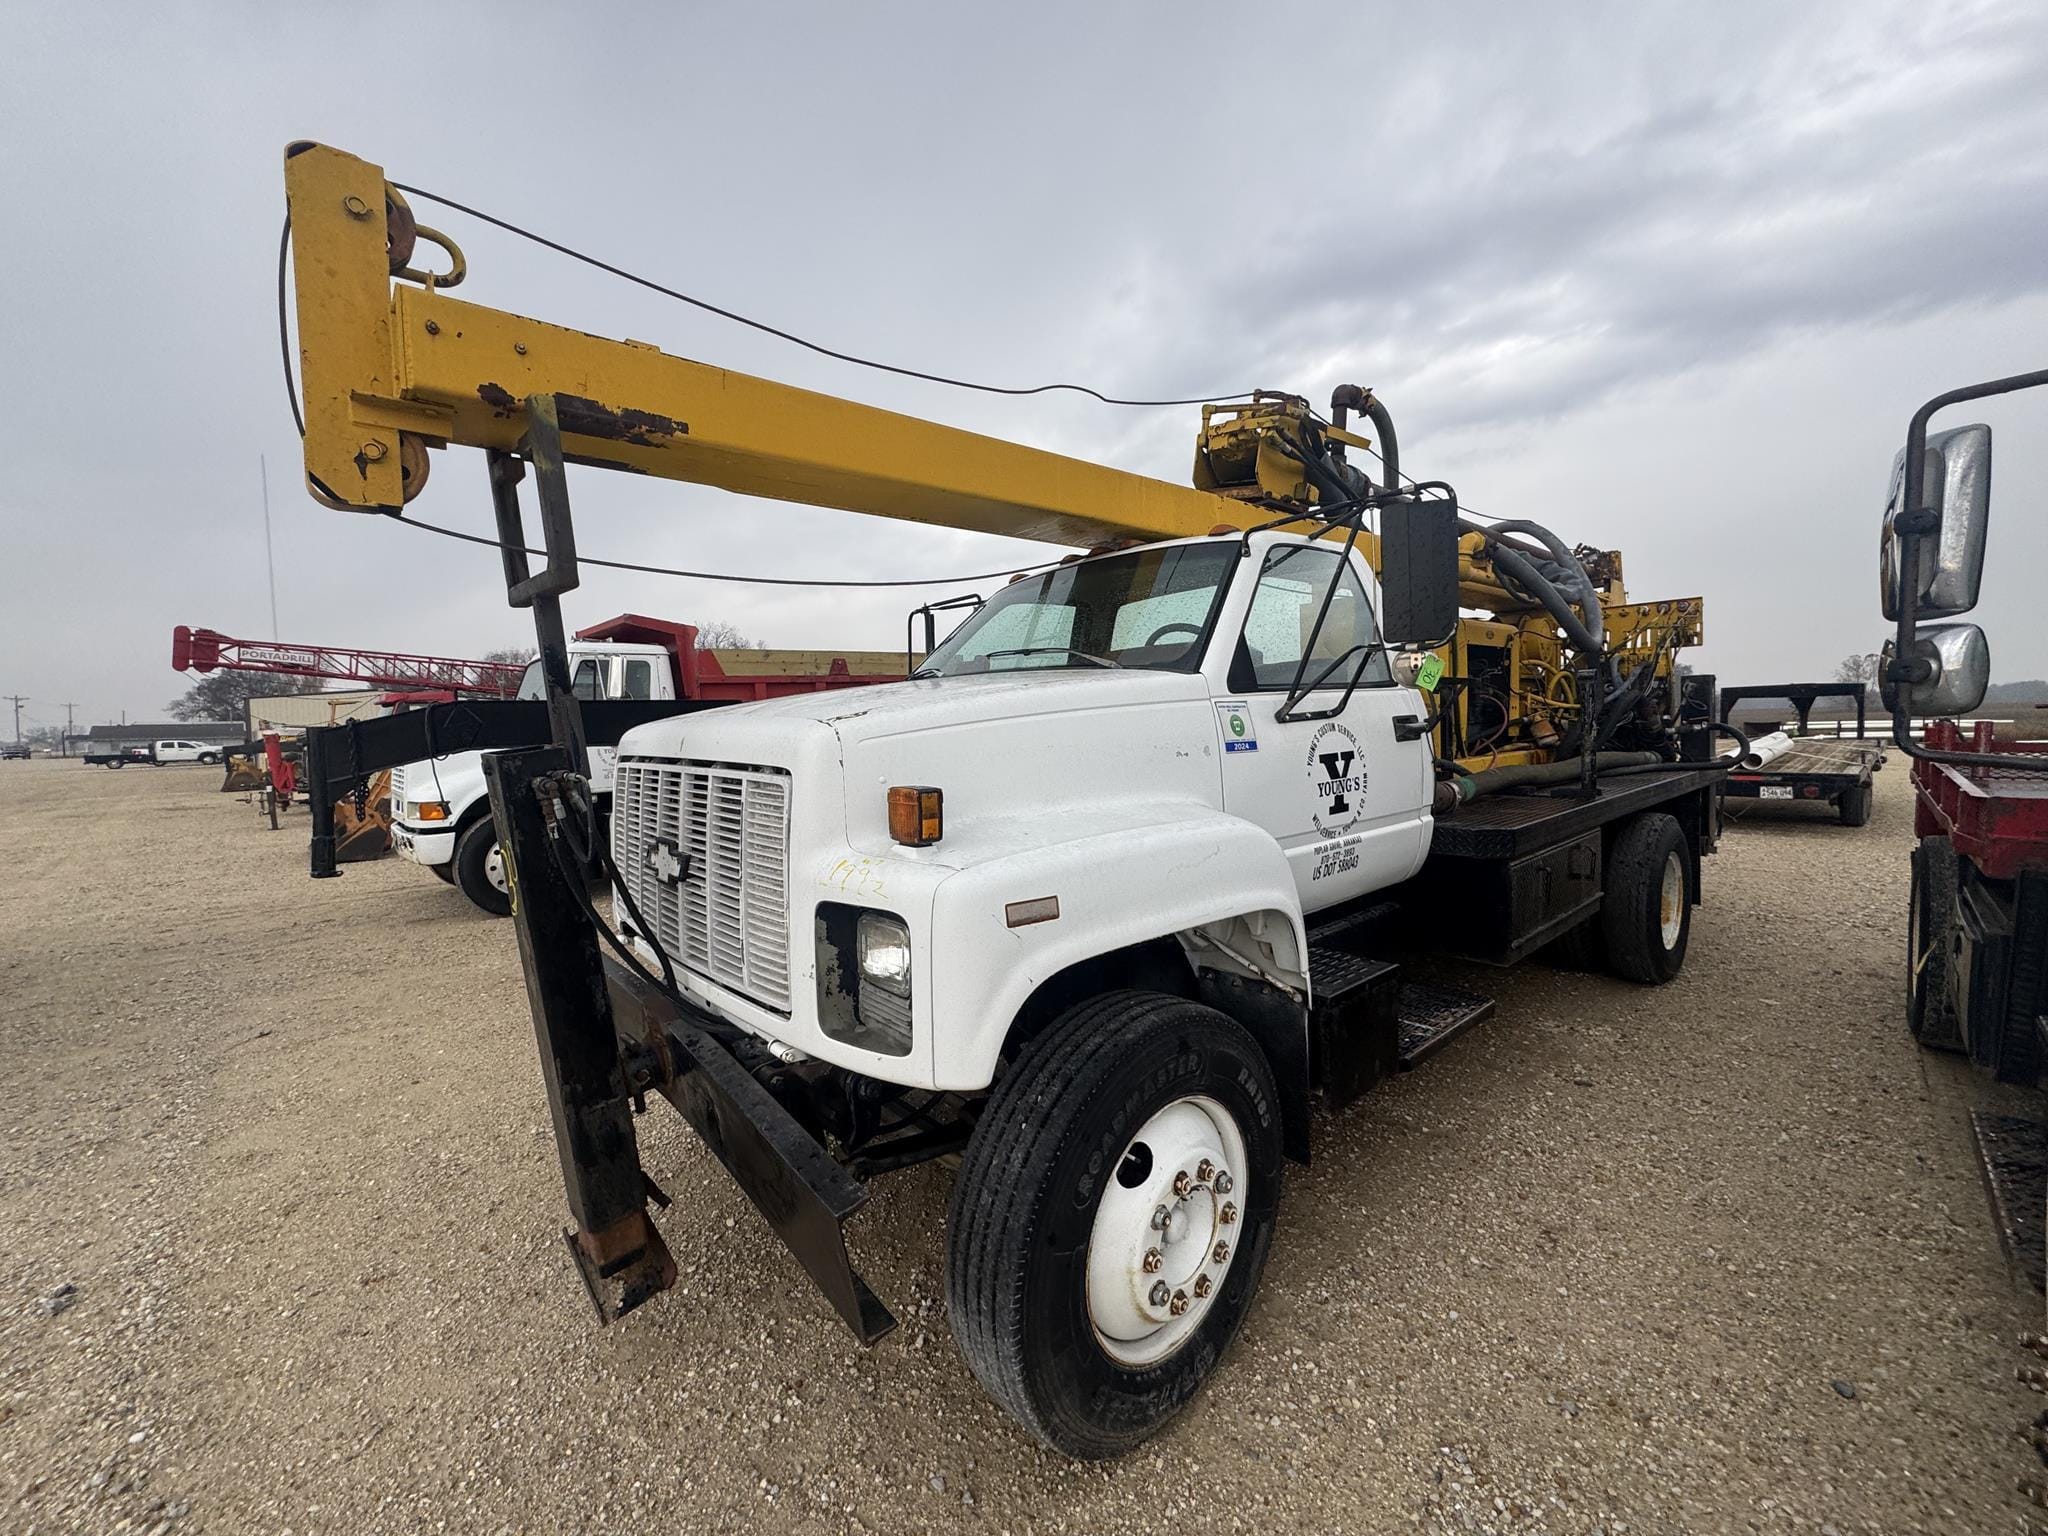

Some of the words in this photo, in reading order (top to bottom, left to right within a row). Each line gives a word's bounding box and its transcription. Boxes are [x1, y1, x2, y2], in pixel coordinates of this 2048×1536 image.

[242, 650, 313, 664] PORTADRILL
[1307, 734, 1320, 767] YOUNG'S
[1317, 722, 1337, 738] CUSTOM
[1356, 745, 1365, 761] LLC
[1317, 776, 1361, 798] YOUNG'S
[1319, 750, 1355, 816] Y
[1311, 812, 1322, 832] WELL
[1312, 865, 1322, 881] US
[1323, 861, 1337, 878] DOT
